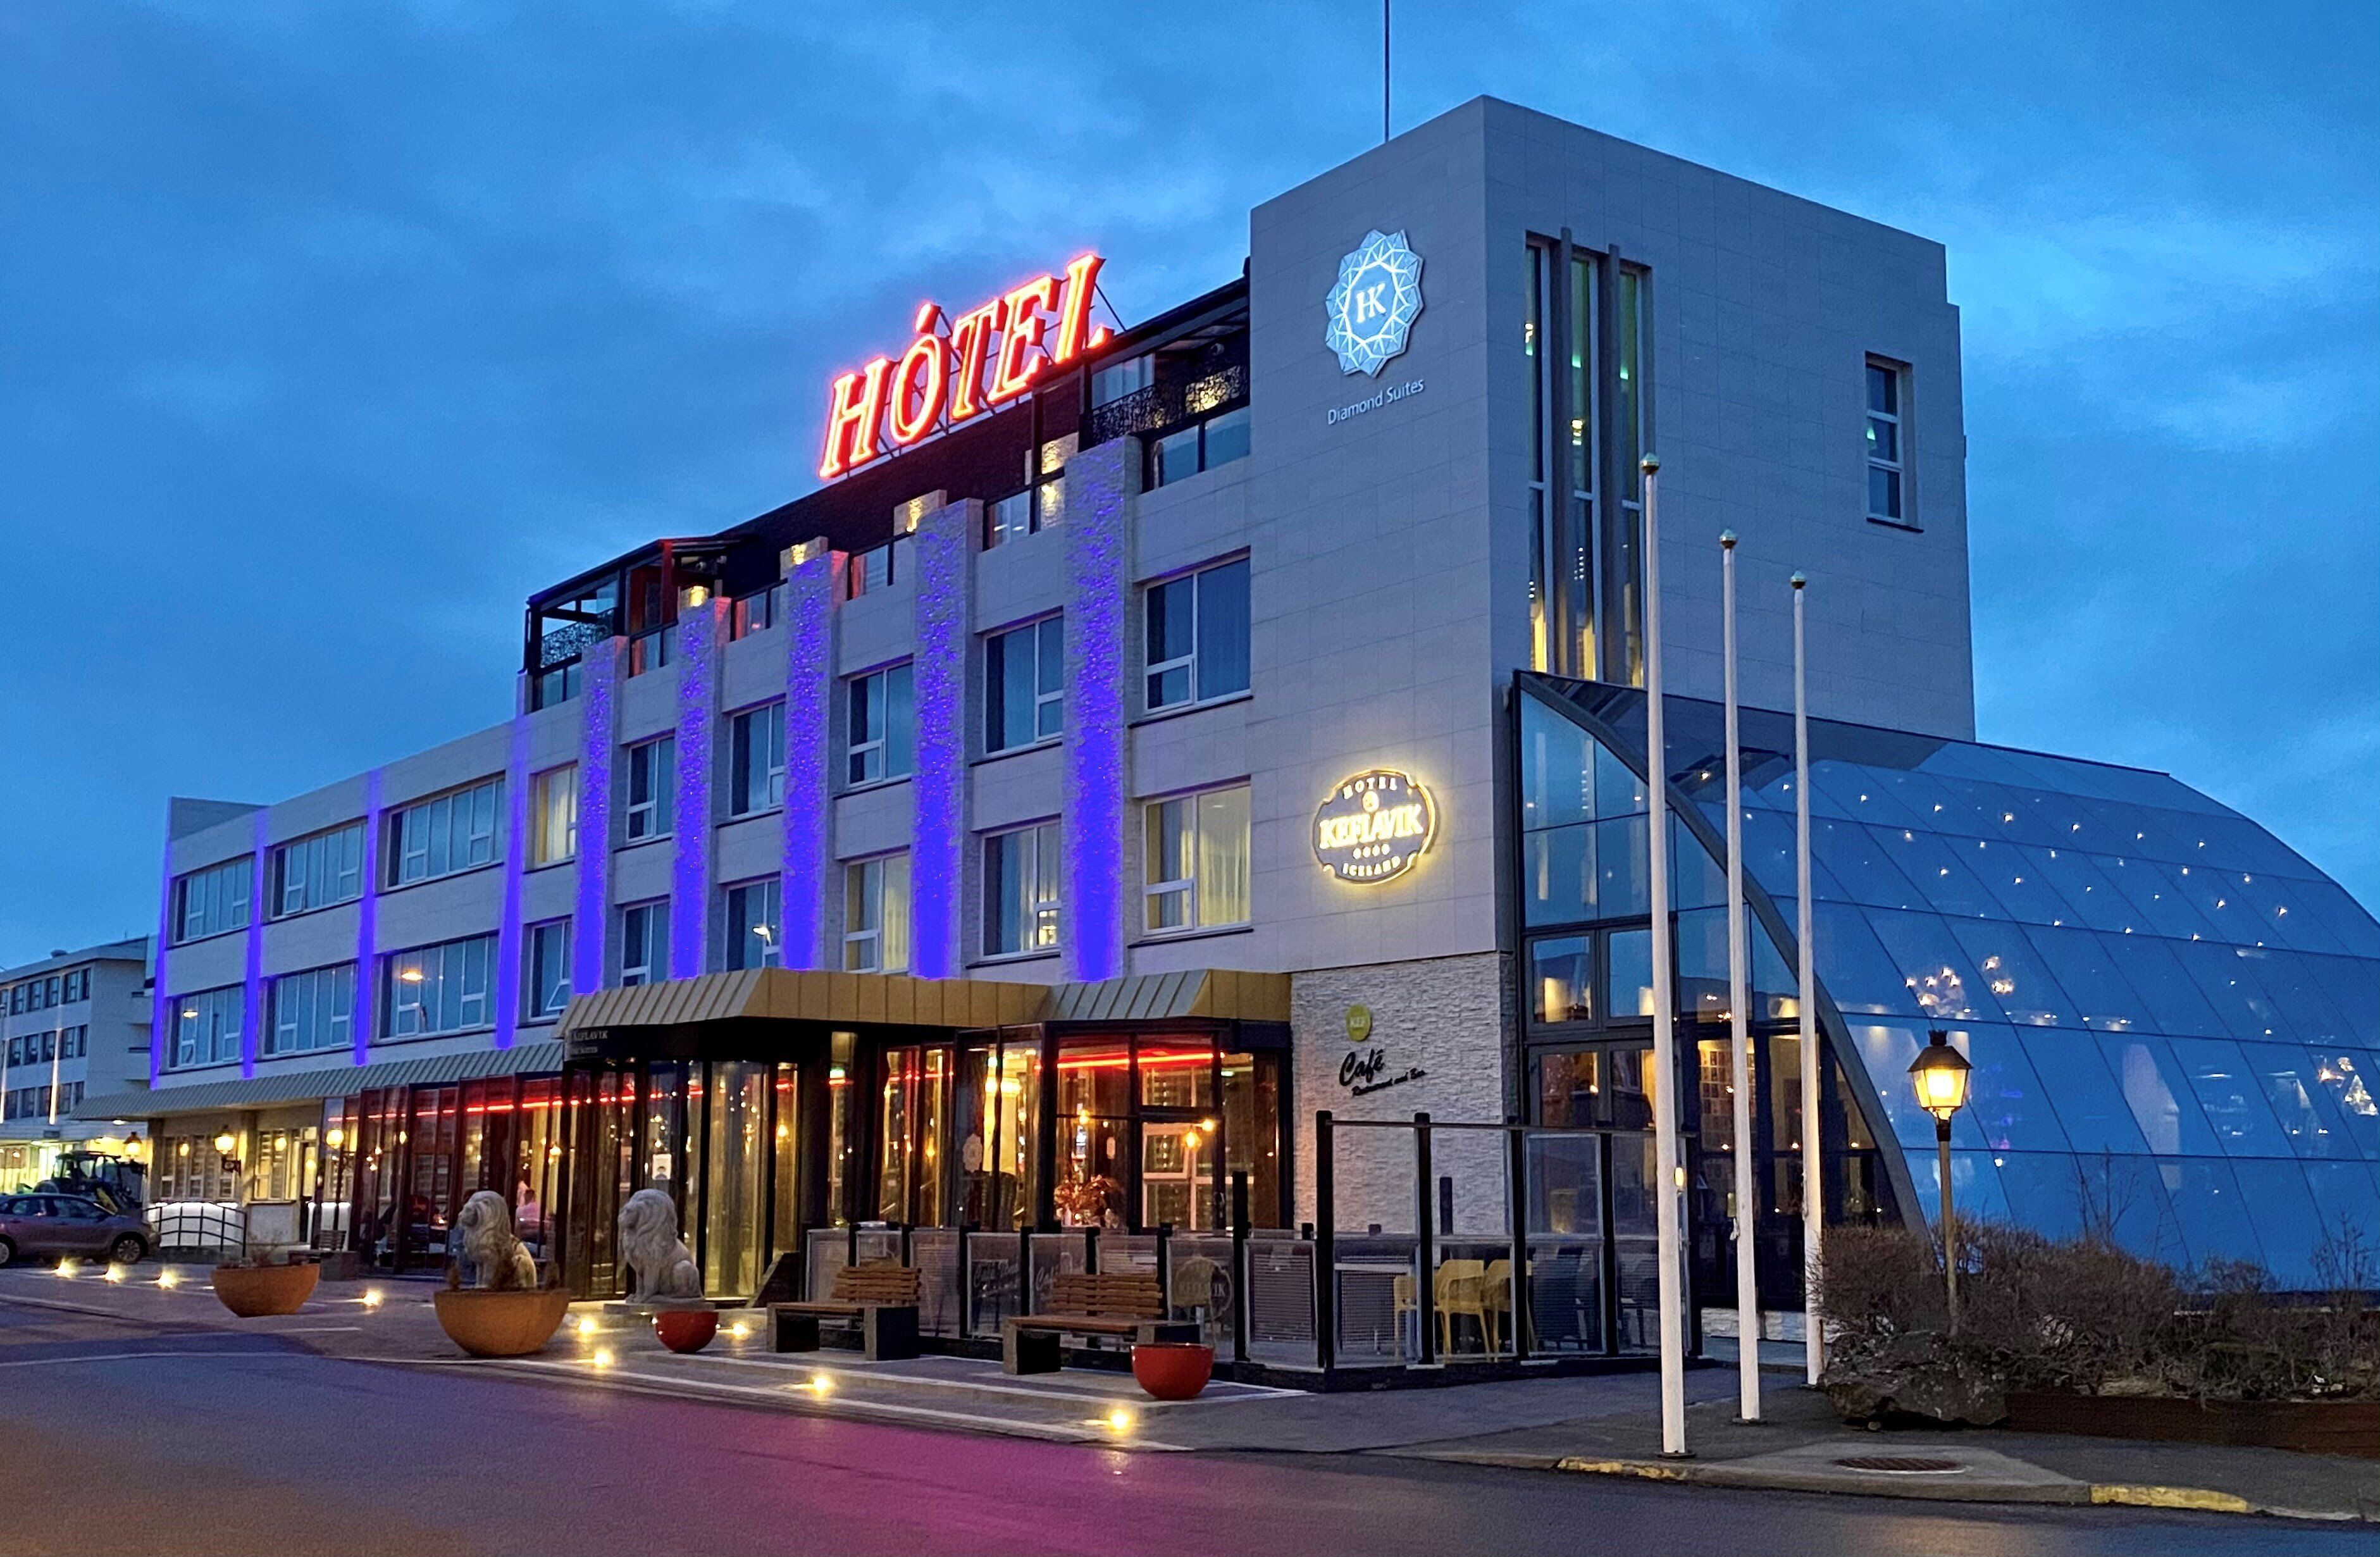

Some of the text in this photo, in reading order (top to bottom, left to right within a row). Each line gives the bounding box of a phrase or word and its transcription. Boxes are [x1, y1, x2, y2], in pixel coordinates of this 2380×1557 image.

[1356, 283, 1386, 323] HK
[819, 254, 1115, 478] HÓTEL
[1328, 379, 1425, 425] Diamond Suites
[1343, 776, 1398, 800] HOTEL
[1319, 803, 1424, 850] KEFLAVIK
[1342, 855, 1401, 877] ICELAND
[1339, 1049, 1384, 1086] Café
